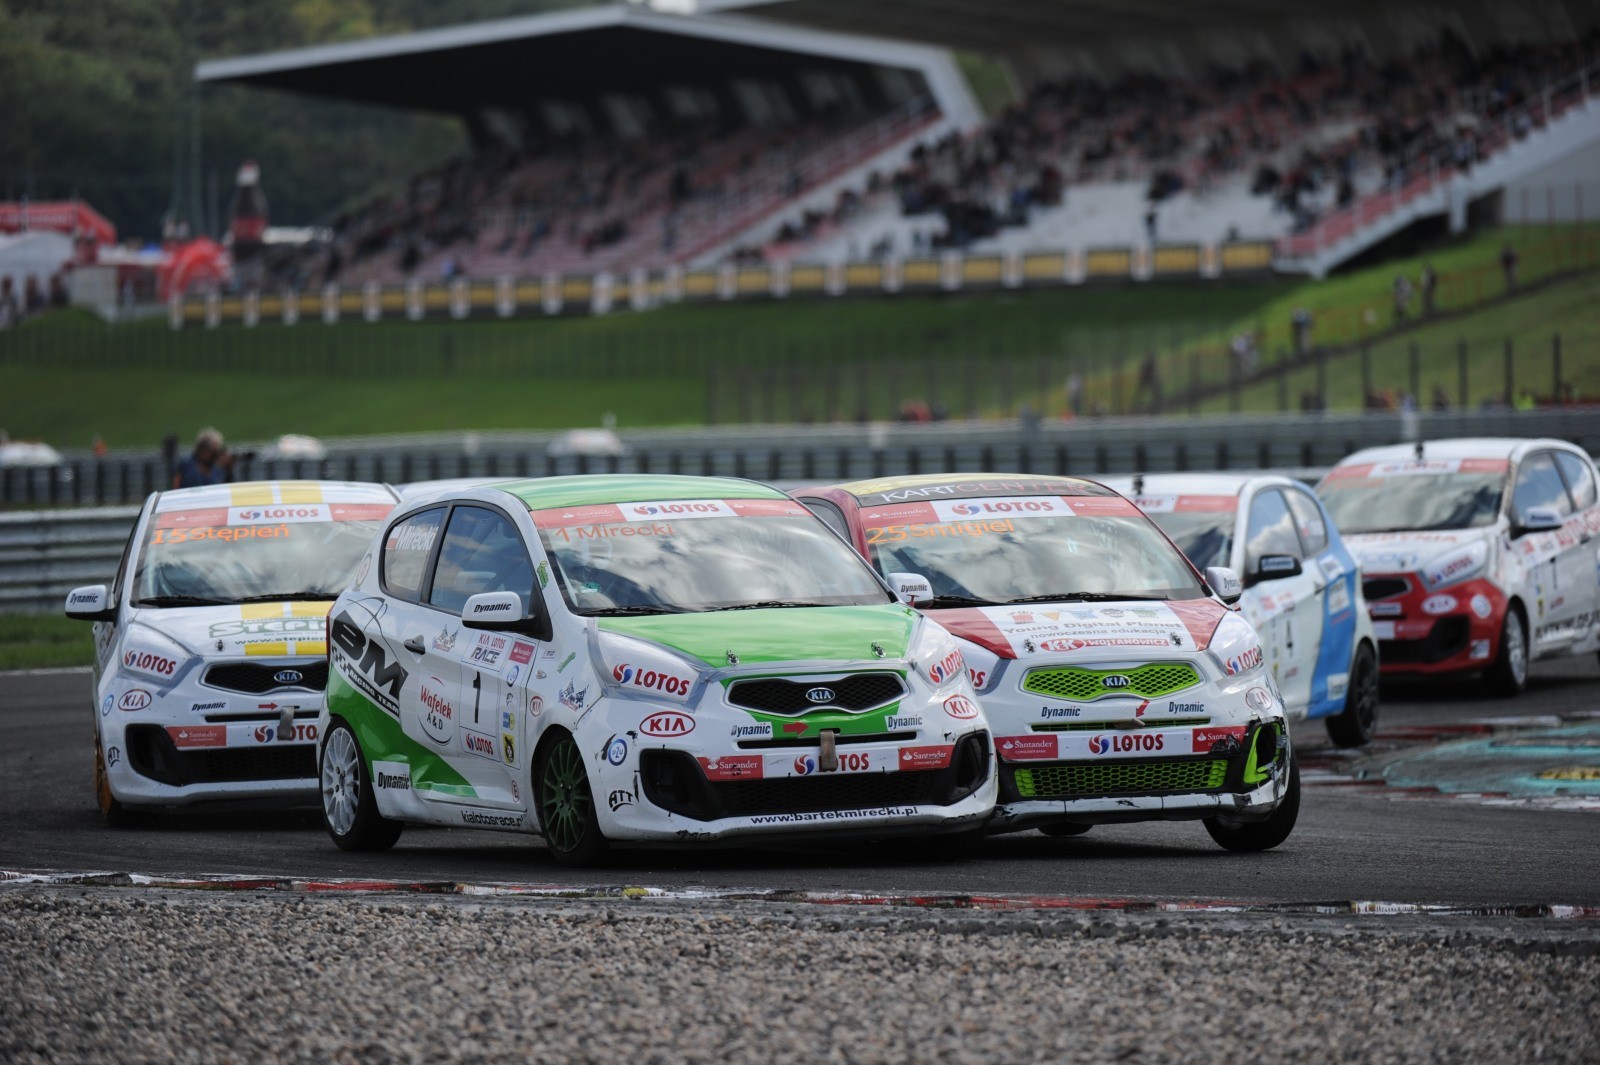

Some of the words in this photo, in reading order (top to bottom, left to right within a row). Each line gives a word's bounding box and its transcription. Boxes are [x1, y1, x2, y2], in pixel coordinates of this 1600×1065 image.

[264, 508, 319, 518] LOTOS
[662, 503, 719, 514] LOTOS
[986, 501, 1054, 513] LOTOS
[577, 524, 674, 540] Mirecki
[901, 584, 928, 593] Dynamic
[70, 593, 98, 605] Dynamic
[474, 602, 511, 613] Dynamic
[1003, 623, 1059, 633] Young
[1064, 621, 1120, 629] Digital
[1031, 629, 1108, 639] nowoczesna
[478, 633, 490, 644] KIA
[491, 636, 507, 650] LOTOS
[331, 610, 409, 700] BM
[471, 647, 501, 663] RACE
[1237, 646, 1262, 671] LOTO
[136, 652, 177, 675] LOTOS
[277, 671, 298, 681] KIA
[634, 668, 690, 696] LOTOS
[1105, 678, 1127, 686] KIA
[122, 695, 145, 707] KIA
[473, 671, 481, 723] 1
[810, 690, 831, 700] KIA
[191, 701, 226, 711] Dynamic
[378, 694, 399, 714] TEAM
[420, 685, 452, 720] Wafelek
[950, 701, 974, 715] KIA
[1168, 701, 1204, 714] Dynamic
[1041, 706, 1081, 718] Dynamic
[427, 713, 432, 722] A
[438, 719, 443, 730] D
[650, 718, 686, 732] KIA
[887, 713, 923, 729] Dynamic
[731, 722, 771, 738] Dynamic
[473, 736, 494, 755] LOTOS
[1014, 740, 1053, 748] Santander
[1113, 734, 1164, 752] LOTOS
[719, 760, 758, 769] Santander
[378, 771, 410, 790] Dynamic
[609, 790, 634, 808] ATT
[751, 806, 919, 824] www.bartekmirecki.pl
